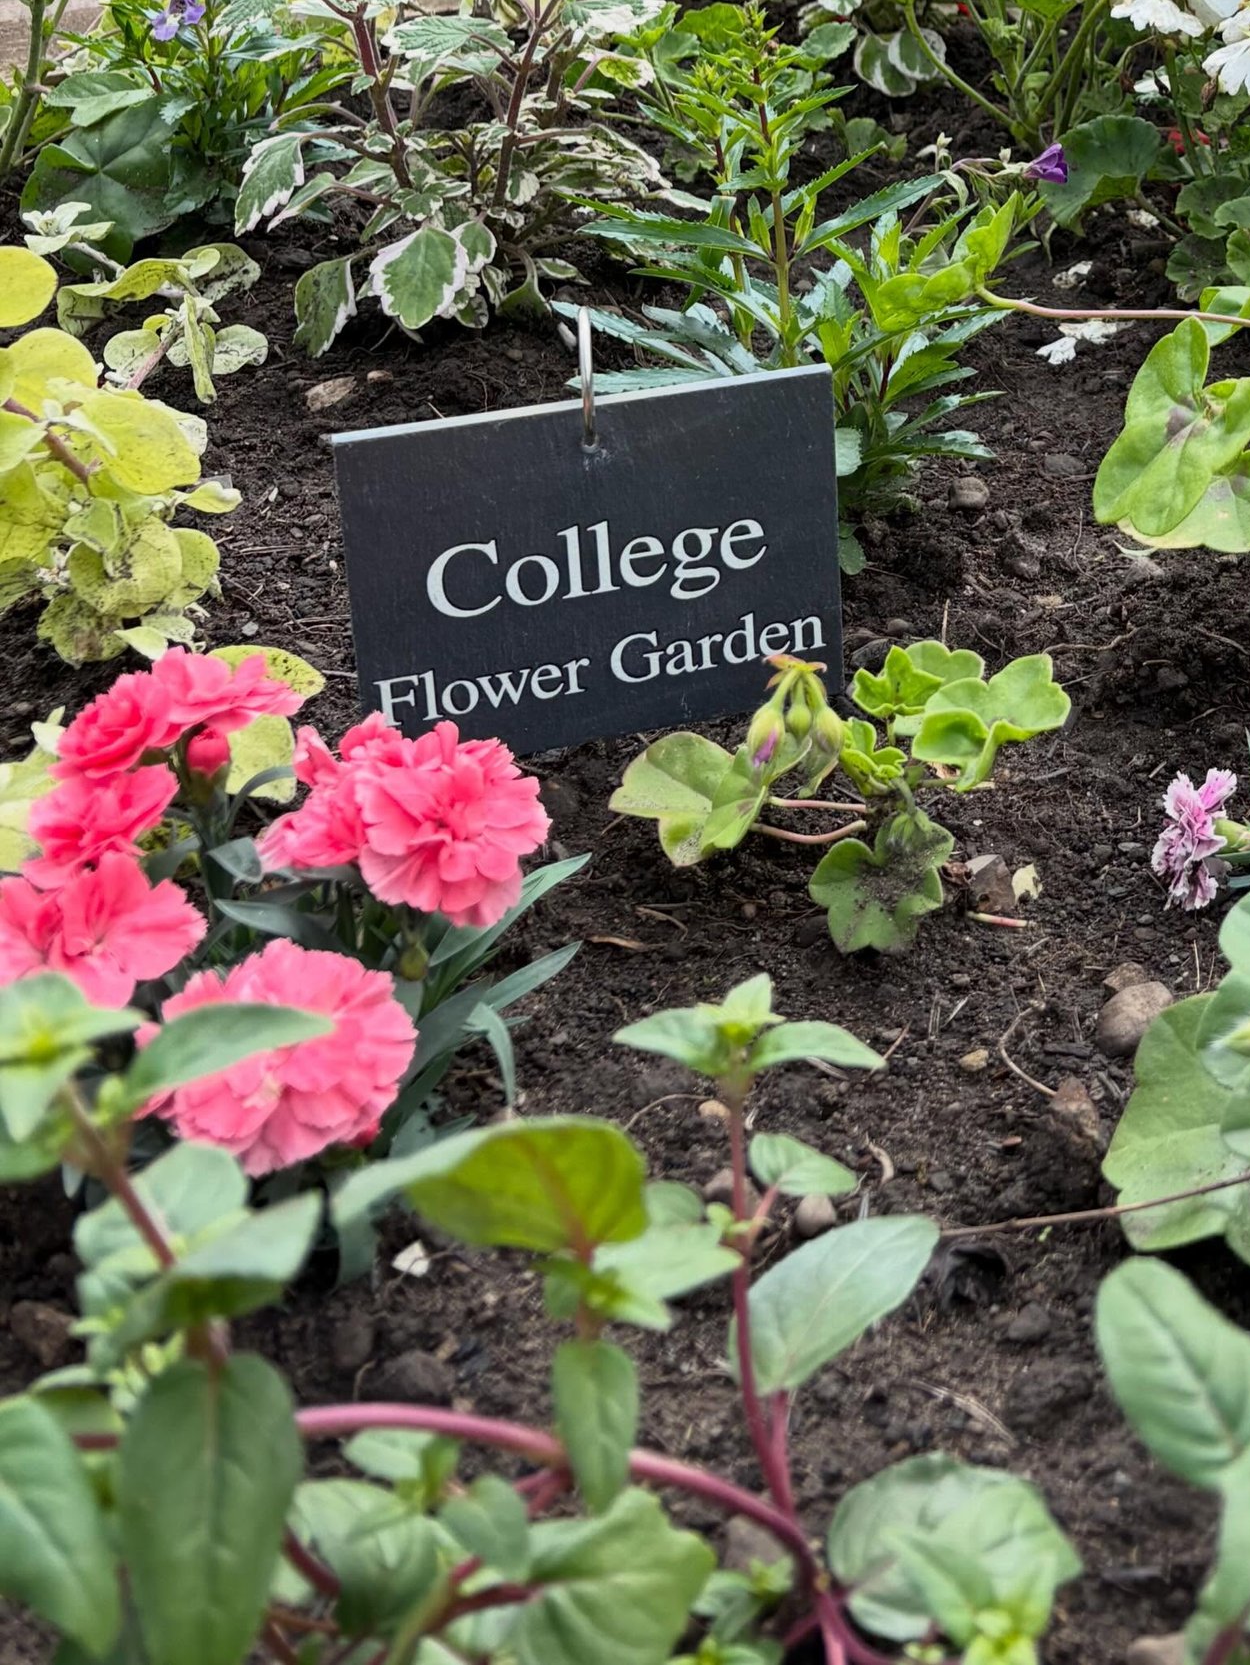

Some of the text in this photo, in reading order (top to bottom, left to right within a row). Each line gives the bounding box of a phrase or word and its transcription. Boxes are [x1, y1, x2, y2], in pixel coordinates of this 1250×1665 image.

[426, 518, 767, 618] College
[374, 613, 827, 726] Flower Garden
